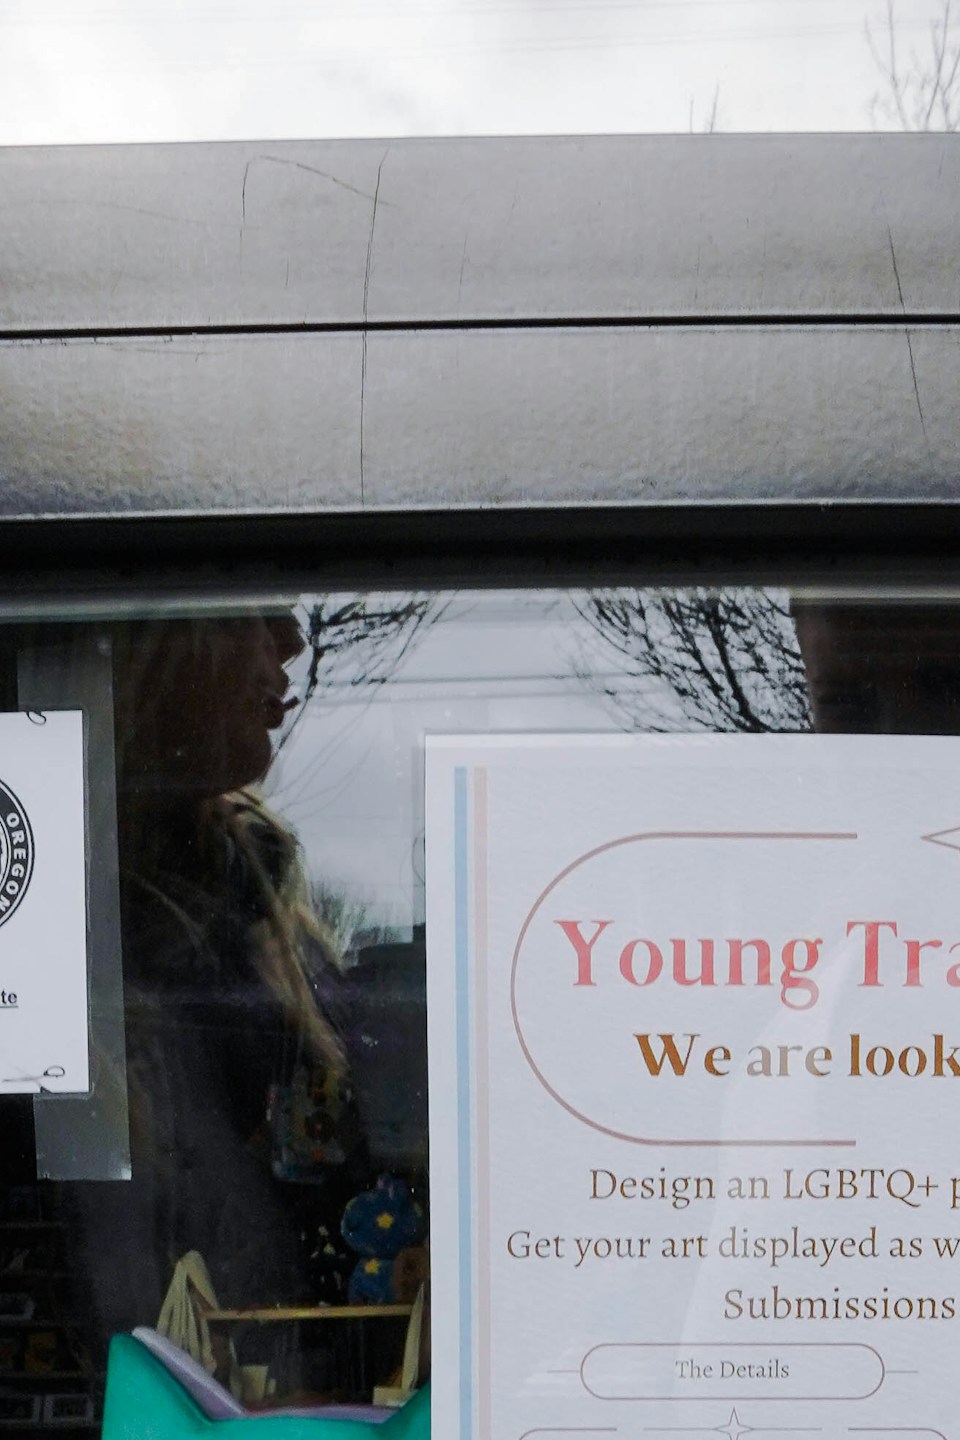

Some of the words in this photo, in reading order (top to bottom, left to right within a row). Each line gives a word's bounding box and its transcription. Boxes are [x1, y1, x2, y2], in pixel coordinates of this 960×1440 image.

[553, 919, 824, 1011] Young
[632, 1032, 732, 1078] We
[746, 1045, 833, 1078] are
[589, 1166, 716, 1210] Design
[727, 1176, 771, 1200] an
[783, 1168, 940, 1209] LGBTQ+
[506, 1230, 566, 1259] Get
[573, 1237, 652, 1268] your
[661, 1234, 709, 1259] art
[718, 1225, 880, 1268] displayed
[889, 1236, 923, 1259] as
[723, 1284, 957, 1321] Submissions
[675, 1359, 713, 1379] The
[720, 1358, 790, 1379] Details
